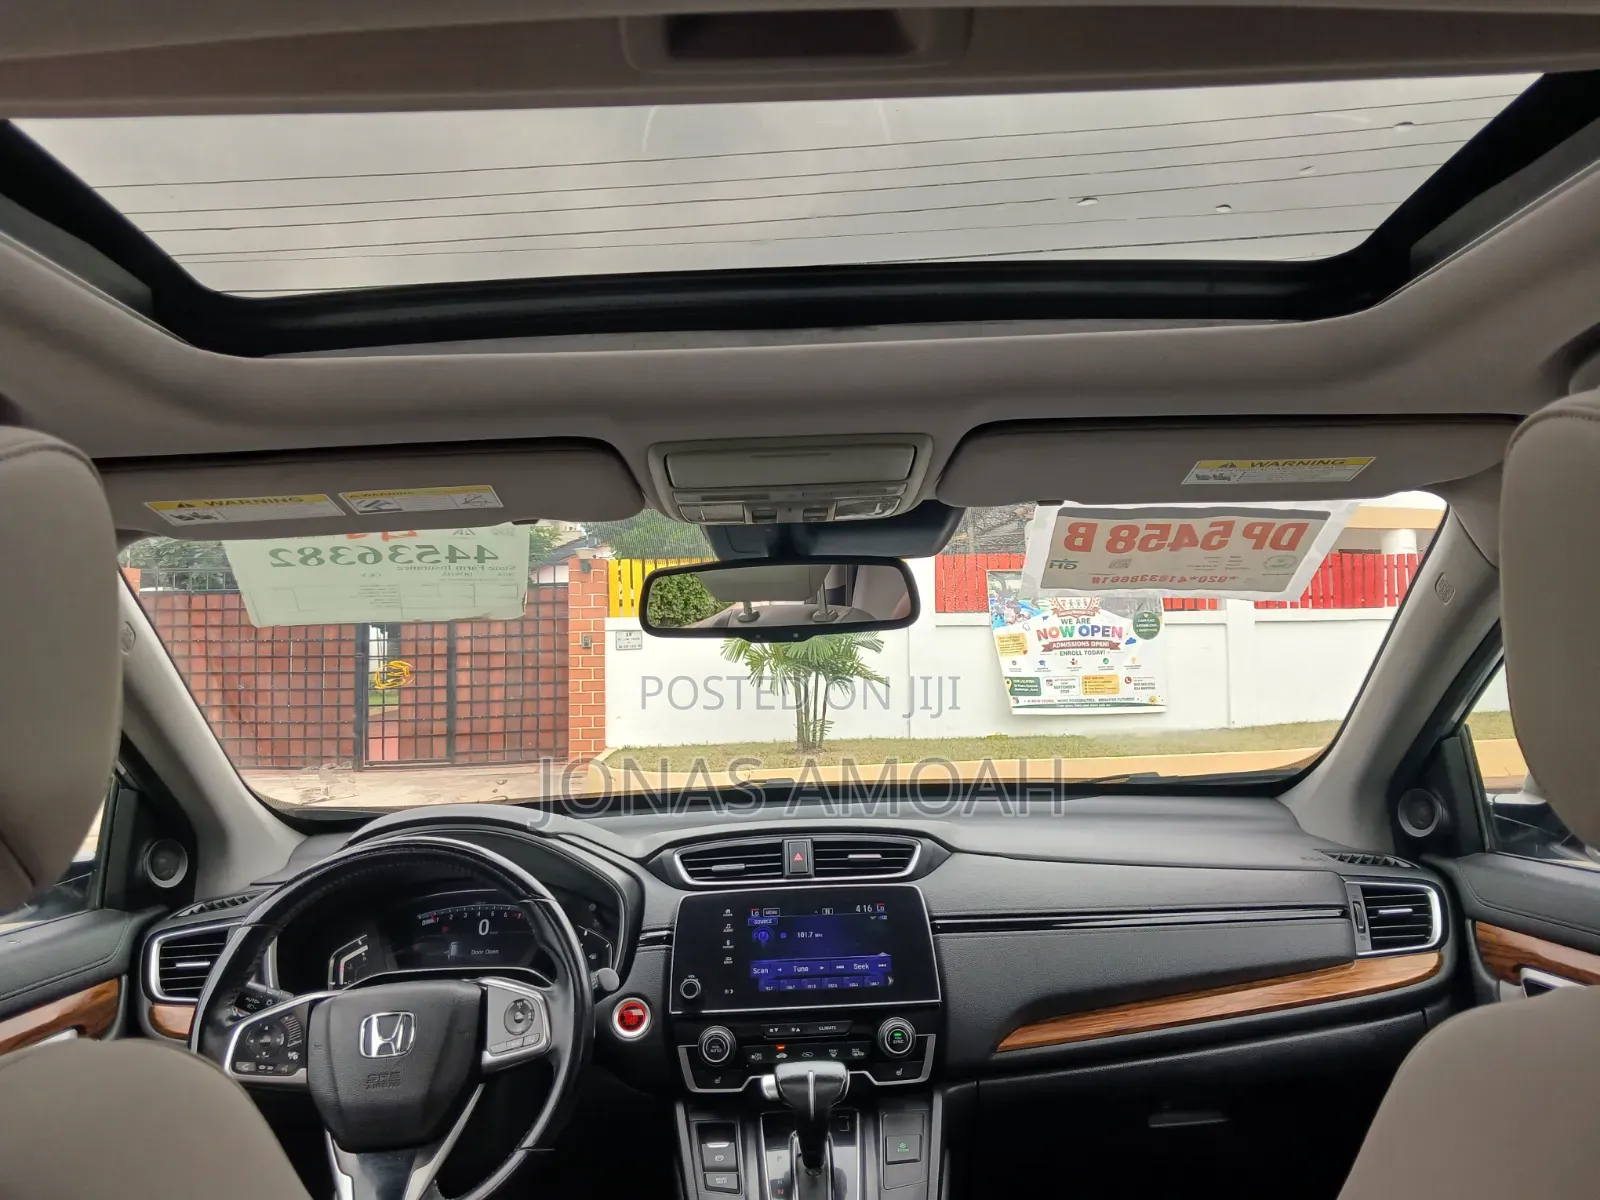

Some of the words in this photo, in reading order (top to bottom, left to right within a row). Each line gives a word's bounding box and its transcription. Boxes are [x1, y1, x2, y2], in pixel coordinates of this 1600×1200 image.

[1250, 459, 1346, 468] WARNING
[204, 496, 303, 507] WARNING
[1076, 617, 1091, 625] ARE
[1036, 625, 1075, 641] NOW
[1078, 624, 1123, 639] OPEN
[1052, 641, 1090, 649] ADMISSIONS
[1090, 640, 1110, 648] OPEN!
[478, 919, 490, 936] 0
[797, 931, 814, 939] 101.7
[752, 967, 769, 975] Scan
[793, 965, 809, 973] Tune
[853, 962, 870, 971] Seek
[245, 996, 260, 1004] AUTO
